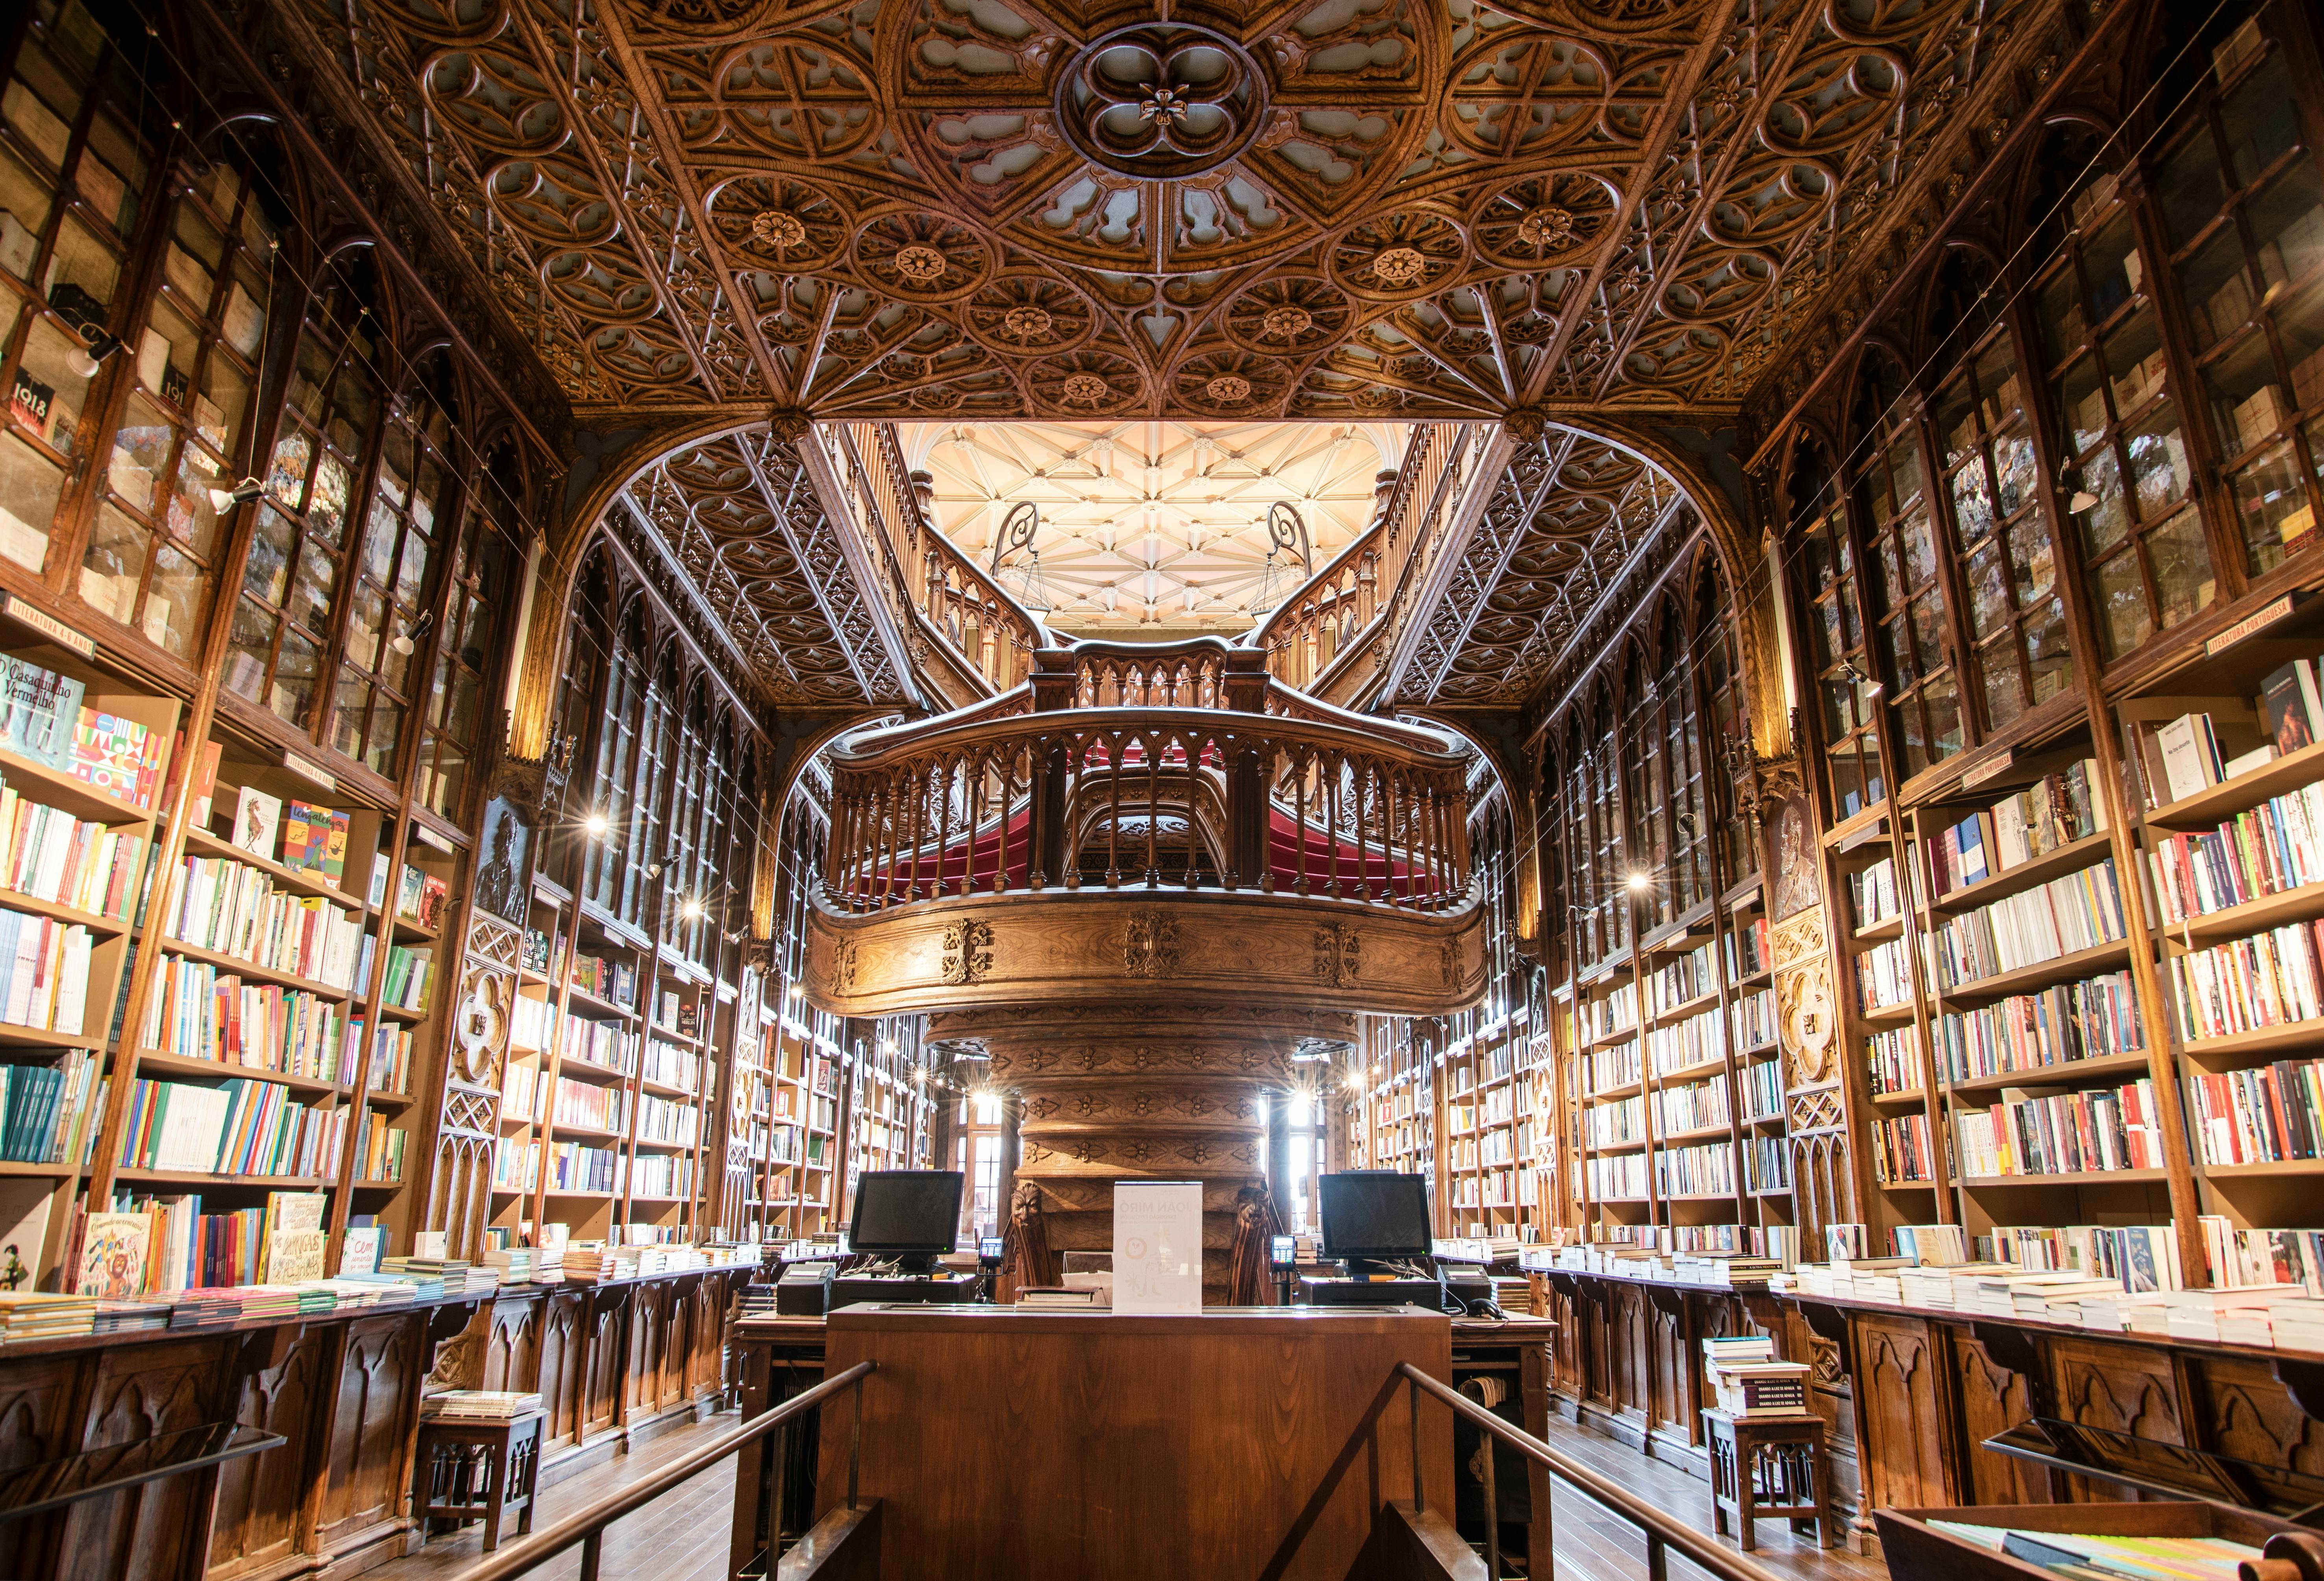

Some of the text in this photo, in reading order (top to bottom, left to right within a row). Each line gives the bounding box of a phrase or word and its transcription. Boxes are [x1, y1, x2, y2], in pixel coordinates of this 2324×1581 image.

[13, 382, 46, 417] 1918
[13, 601, 92, 654] LITERATURA 4-6 ANOS
[2209, 601, 2287, 652] LITERATURA PORTUGUESA
[6, 679, 55, 710] Vermelho
[2178, 739, 2190, 750] deserto
[288, 755, 314, 777] LITERATURA
[322, 776, 334, 788] ANOS
[1964, 755, 2010, 785] LITERATURA PORTUGUESA
[1863, 869, 1874, 881] LAPIDUS
[96, 1216, 115, 1229] mundo
